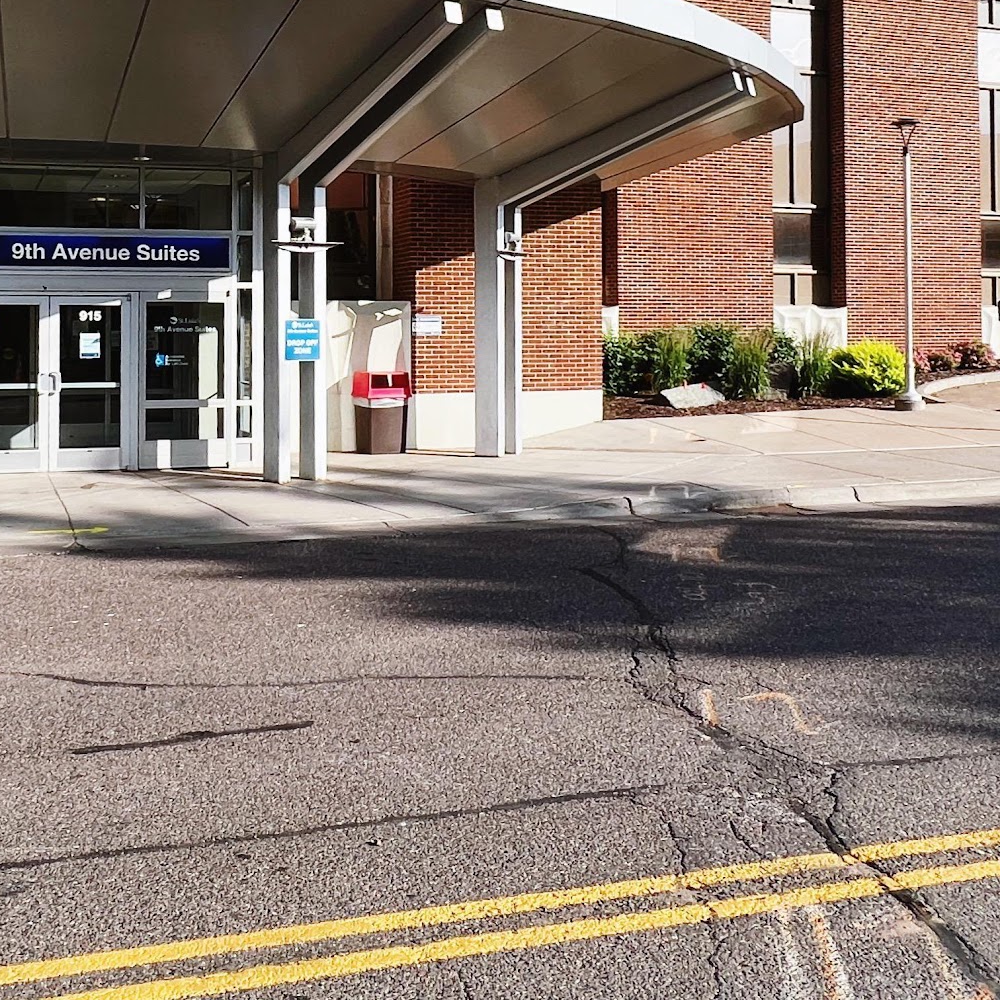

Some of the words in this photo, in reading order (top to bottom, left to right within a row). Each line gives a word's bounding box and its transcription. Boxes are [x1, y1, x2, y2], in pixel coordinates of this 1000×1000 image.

[11, 242, 46, 260] 9th
[52, 243, 131, 261] Avenue
[136, 244, 201, 262] Suites
[79, 310, 102, 321] 915
[153, 325, 166, 333] 9th
[167, 325, 194, 333] Avenue
[286, 339, 305, 347] DROP
[305, 339, 319, 347] OFF
[293, 346, 312, 355] ZONE
